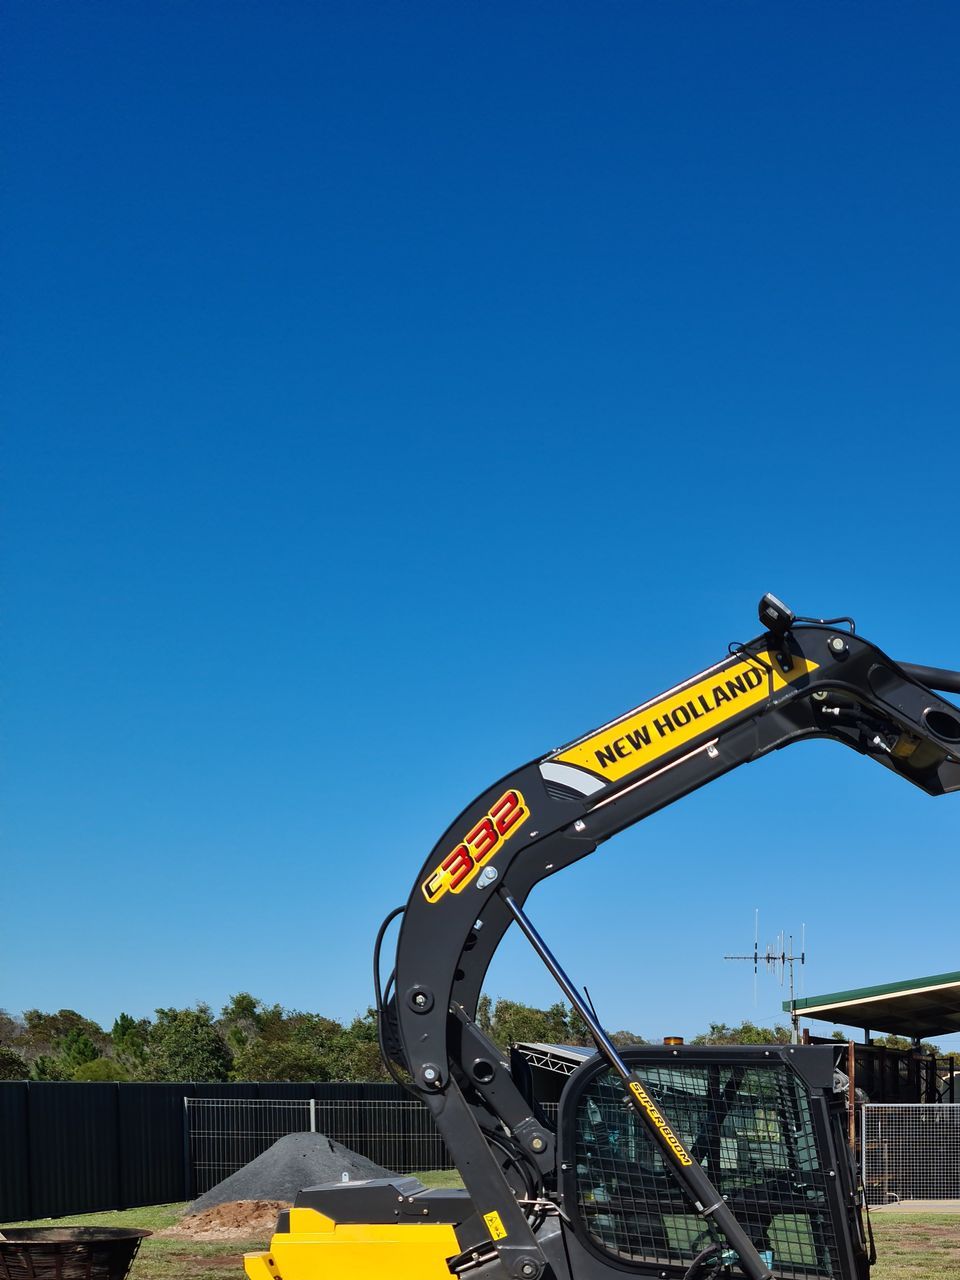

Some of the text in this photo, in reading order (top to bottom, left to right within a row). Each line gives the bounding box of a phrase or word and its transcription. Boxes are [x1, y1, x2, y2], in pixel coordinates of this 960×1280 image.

[594, 668, 763, 768] NEW HOLLAND
[423, 790, 529, 902] C332
[631, 1082, 692, 1165] SUPER BOOM
